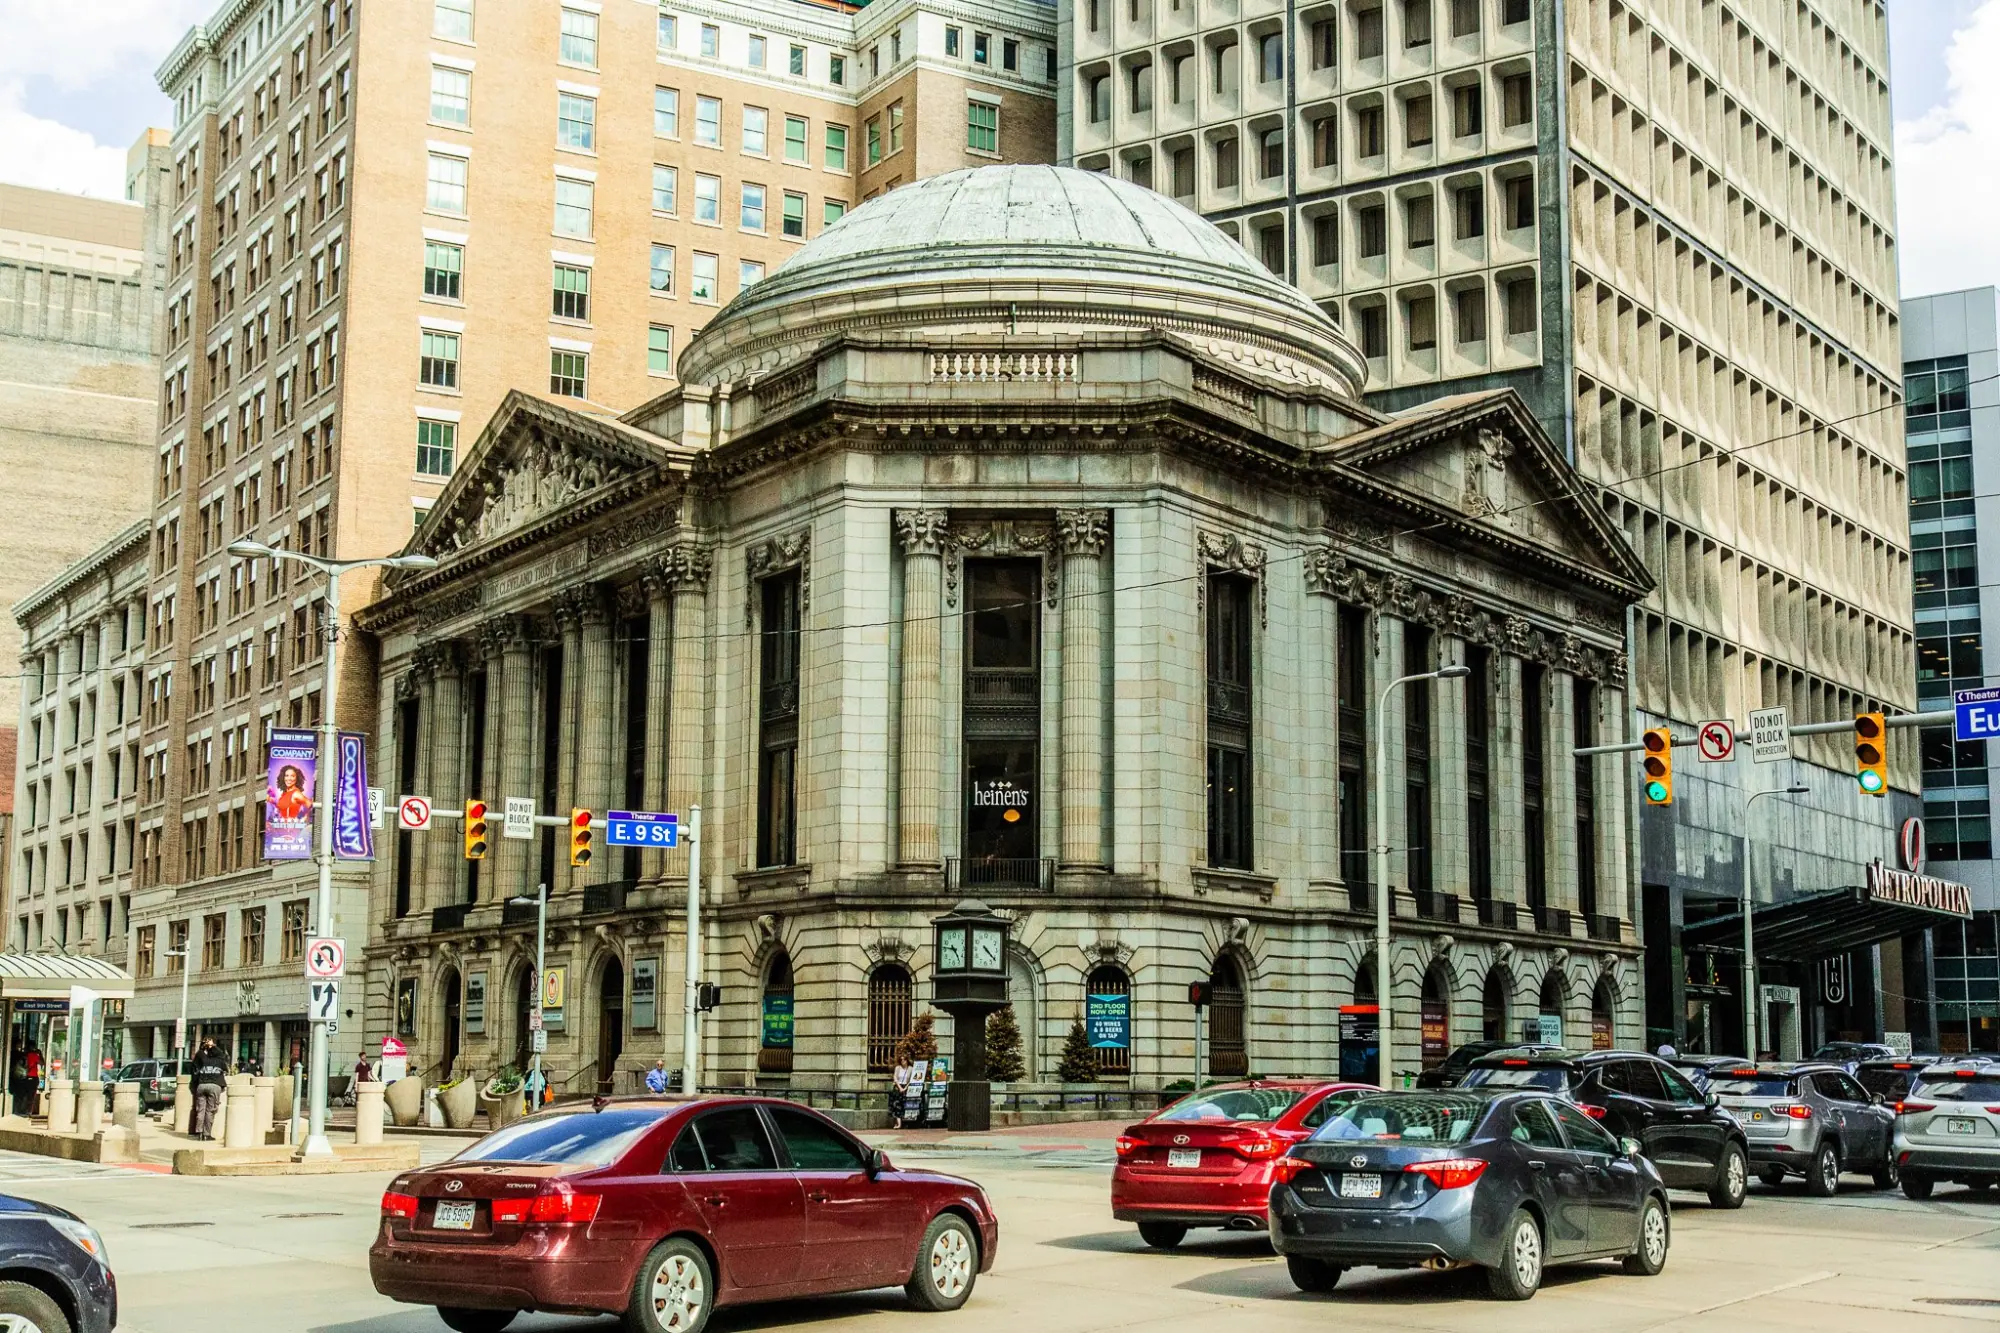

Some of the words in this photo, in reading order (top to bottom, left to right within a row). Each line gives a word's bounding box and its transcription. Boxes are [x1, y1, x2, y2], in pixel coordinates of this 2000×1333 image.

[1964, 690, 2000, 700] Theater
[1754, 716, 1766, 728] DO
[1767, 714, 1784, 726] NOT
[1970, 708, 2000, 732] Eu
[1756, 730, 1784, 744] BLOCK
[273, 748, 312, 758] COMPANY
[1756, 744, 1787, 756] INTERSECTION
[342, 741, 363, 851] COMPANY
[974, 780, 1029, 805] heinen's
[370, 802, 378, 811] LY
[510, 803, 518, 812] DO
[520, 804, 532, 813] NOT
[510, 814, 530, 824] BLOCK
[631, 812, 656, 820] Theater
[616, 824, 630, 840] E.
[635, 825, 647, 841] 9
[651, 826, 670, 842] St
[1868, 858, 1972, 918] METROPOLITAN
[438, 1208, 451, 1220] JCG
[453, 1208, 471, 1221] 5905
